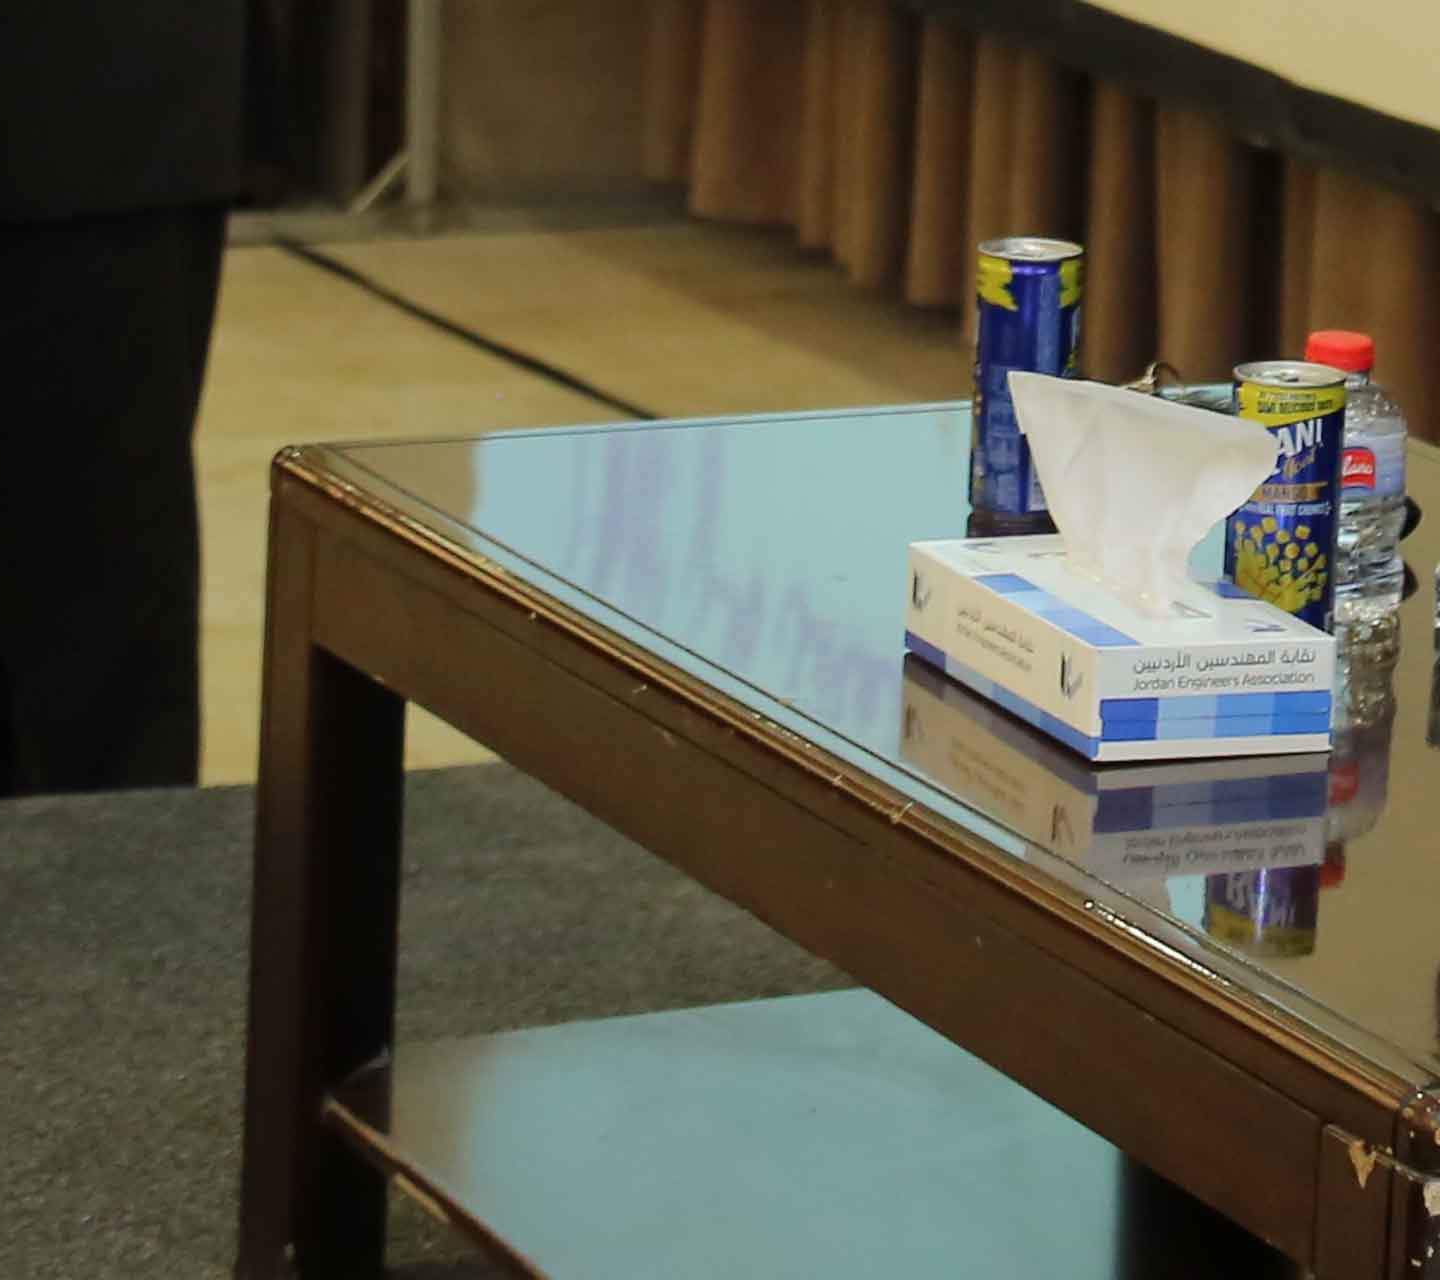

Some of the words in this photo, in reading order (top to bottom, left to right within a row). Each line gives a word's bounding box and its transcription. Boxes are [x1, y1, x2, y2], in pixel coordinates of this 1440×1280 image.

[1275, 417, 1323, 458] ANI
[1134, 677, 1176, 690] Jordan
[1178, 674, 1241, 690] Engineers
[1242, 670, 1315, 686] Association
